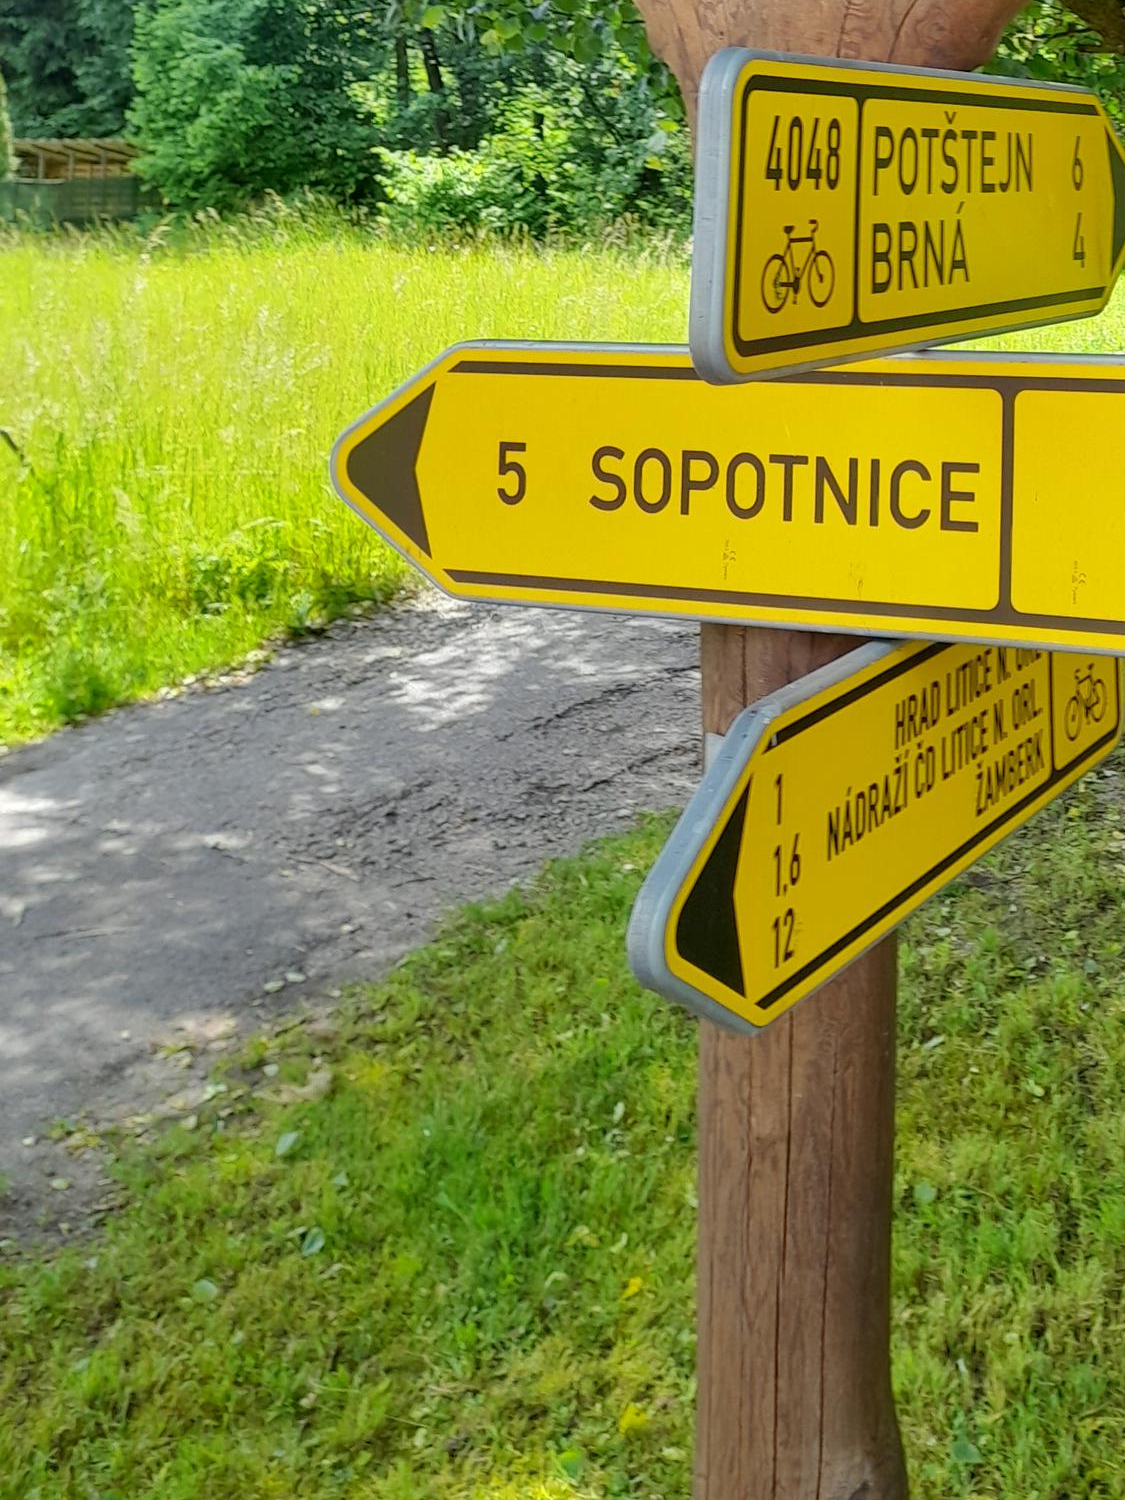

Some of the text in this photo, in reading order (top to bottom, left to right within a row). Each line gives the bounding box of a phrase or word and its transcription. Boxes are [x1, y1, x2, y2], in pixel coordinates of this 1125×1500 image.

[764, 115, 841, 191] 4048
[873, 111, 1083, 196] POTŠTEJN 6
[871, 201, 1085, 294] BRNÁ 4
[497, 441, 980, 533] 5 SOPOTNICE
[774, 773, 783, 825] 1
[895, 679, 940, 750] HRAD
[946, 648, 992, 717] LITICE
[826, 749, 909, 861] NÁDRAŽÍ
[914, 740, 936, 799] ČD
[941, 708, 989, 781] LITICE
[993, 699, 1008, 745] N.
[772, 729, 1045, 969] 12 ŽAMBERK
